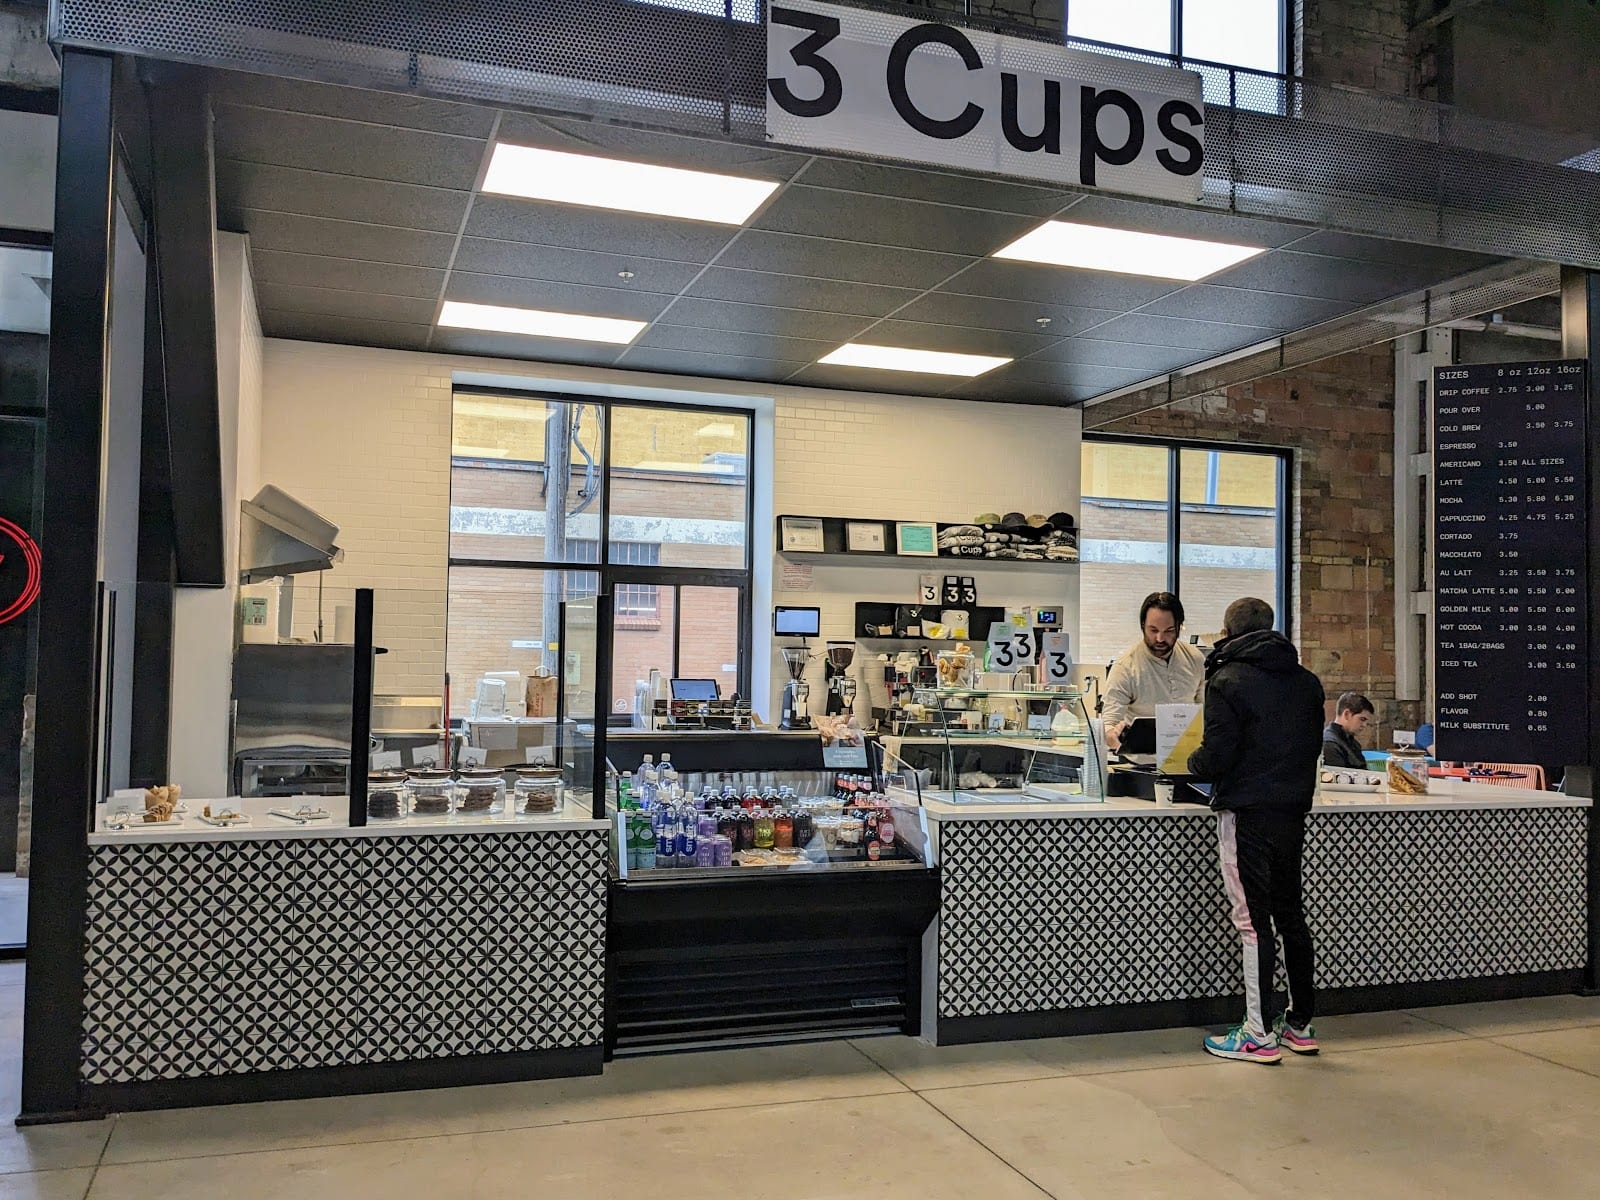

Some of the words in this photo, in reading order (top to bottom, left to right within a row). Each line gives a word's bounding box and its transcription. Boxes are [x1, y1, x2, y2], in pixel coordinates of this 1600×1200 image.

[767, 8, 842, 118] 3
[886, 22, 1204, 186] Cups
[1440, 370, 1469, 380] SIZES
[1558, 365, 1581, 374] 16oz
[1440, 389, 1459, 397] DRIP
[1462, 387, 1490, 395] COFFEE
[1499, 386, 1518, 394] 2.75
[1522, 458, 1536, 466] ALL
[961, 545, 983, 556] Cups
[925, 586, 935, 600] 3
[948, 586, 959, 602] 3
[964, 587, 975, 603] 3
[910, 609, 918, 618] 3
[1014, 633, 1031, 658] 3
[994, 641, 1013, 667] 3
[1050, 652, 1068, 678] 3
[1441, 660, 1460, 668] ICED
[1463, 722, 1510, 731] SUBSTITUTE
